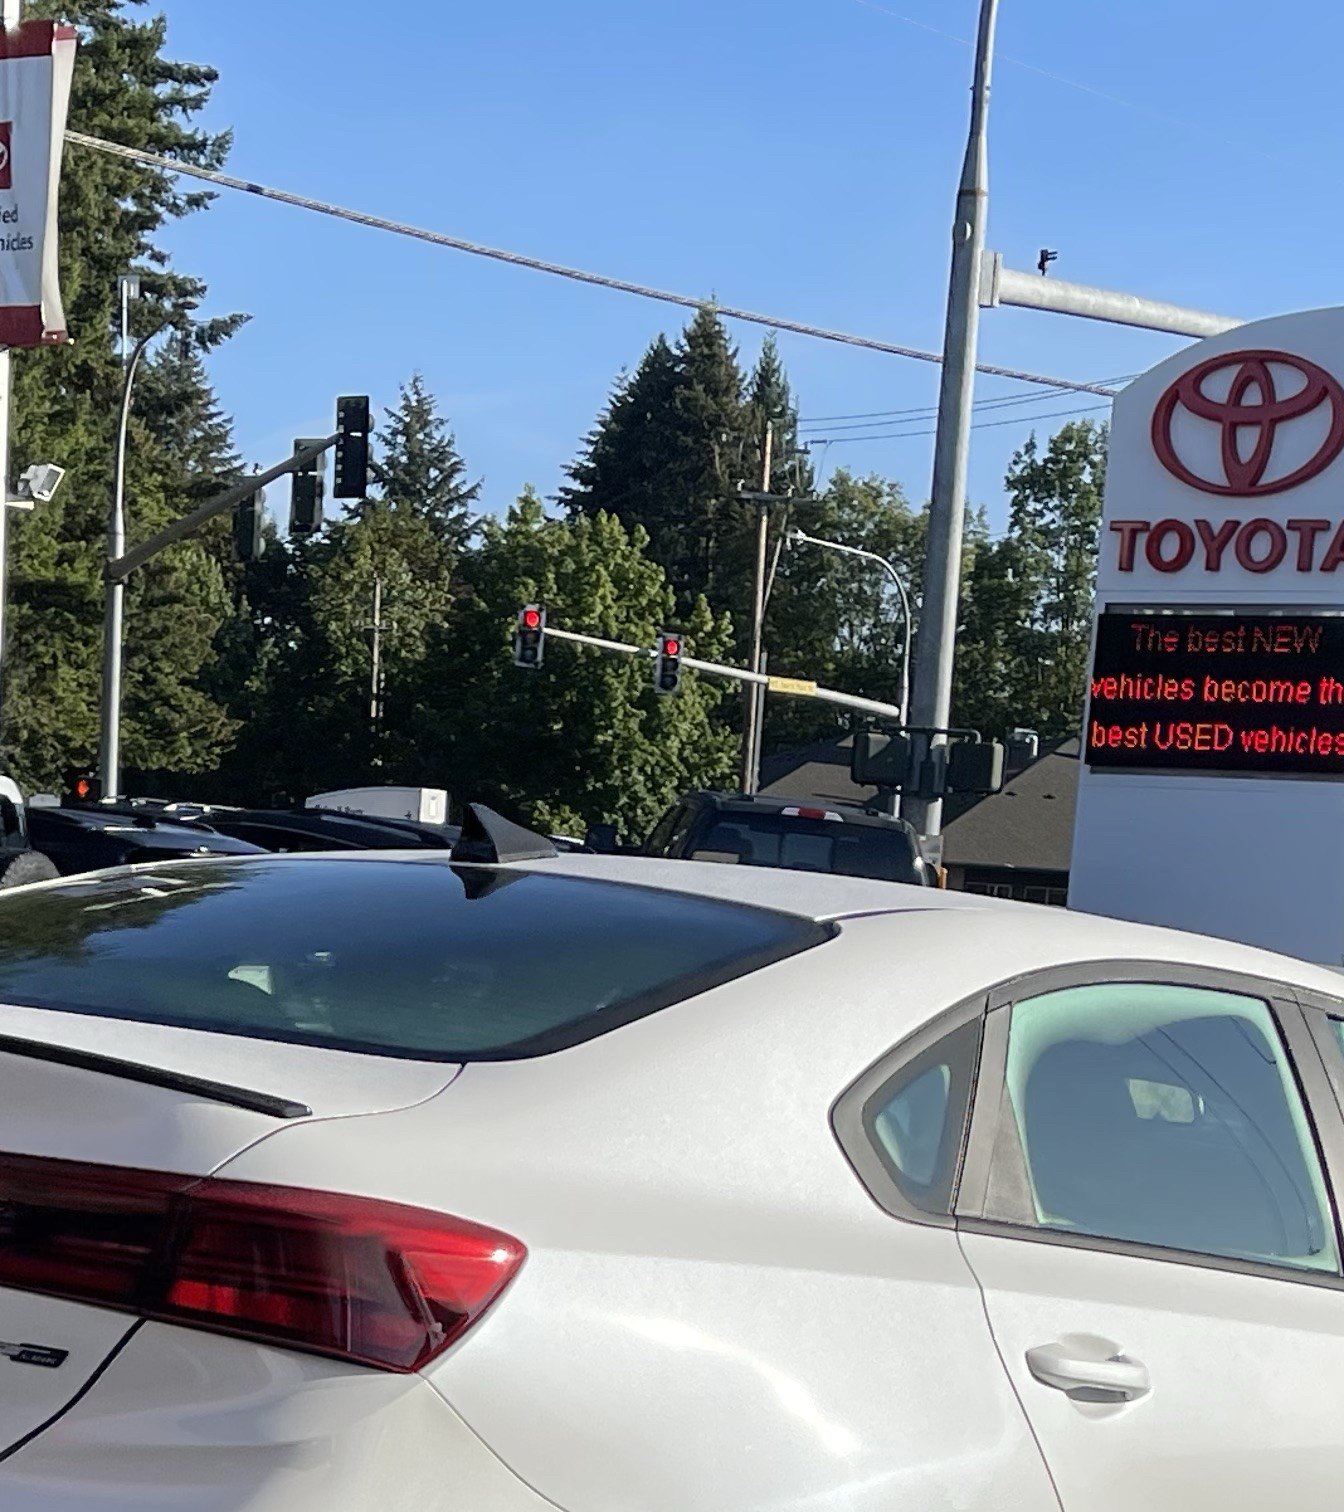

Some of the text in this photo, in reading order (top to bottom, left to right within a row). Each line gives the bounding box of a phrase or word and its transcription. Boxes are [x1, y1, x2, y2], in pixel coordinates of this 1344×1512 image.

[1130, 623, 1324, 654] The best NEW
[1091, 672, 1196, 701] vehicles
[1203, 674, 1312, 704] become
[1090, 720, 1148, 749] best
[1154, 722, 1234, 751] USED
